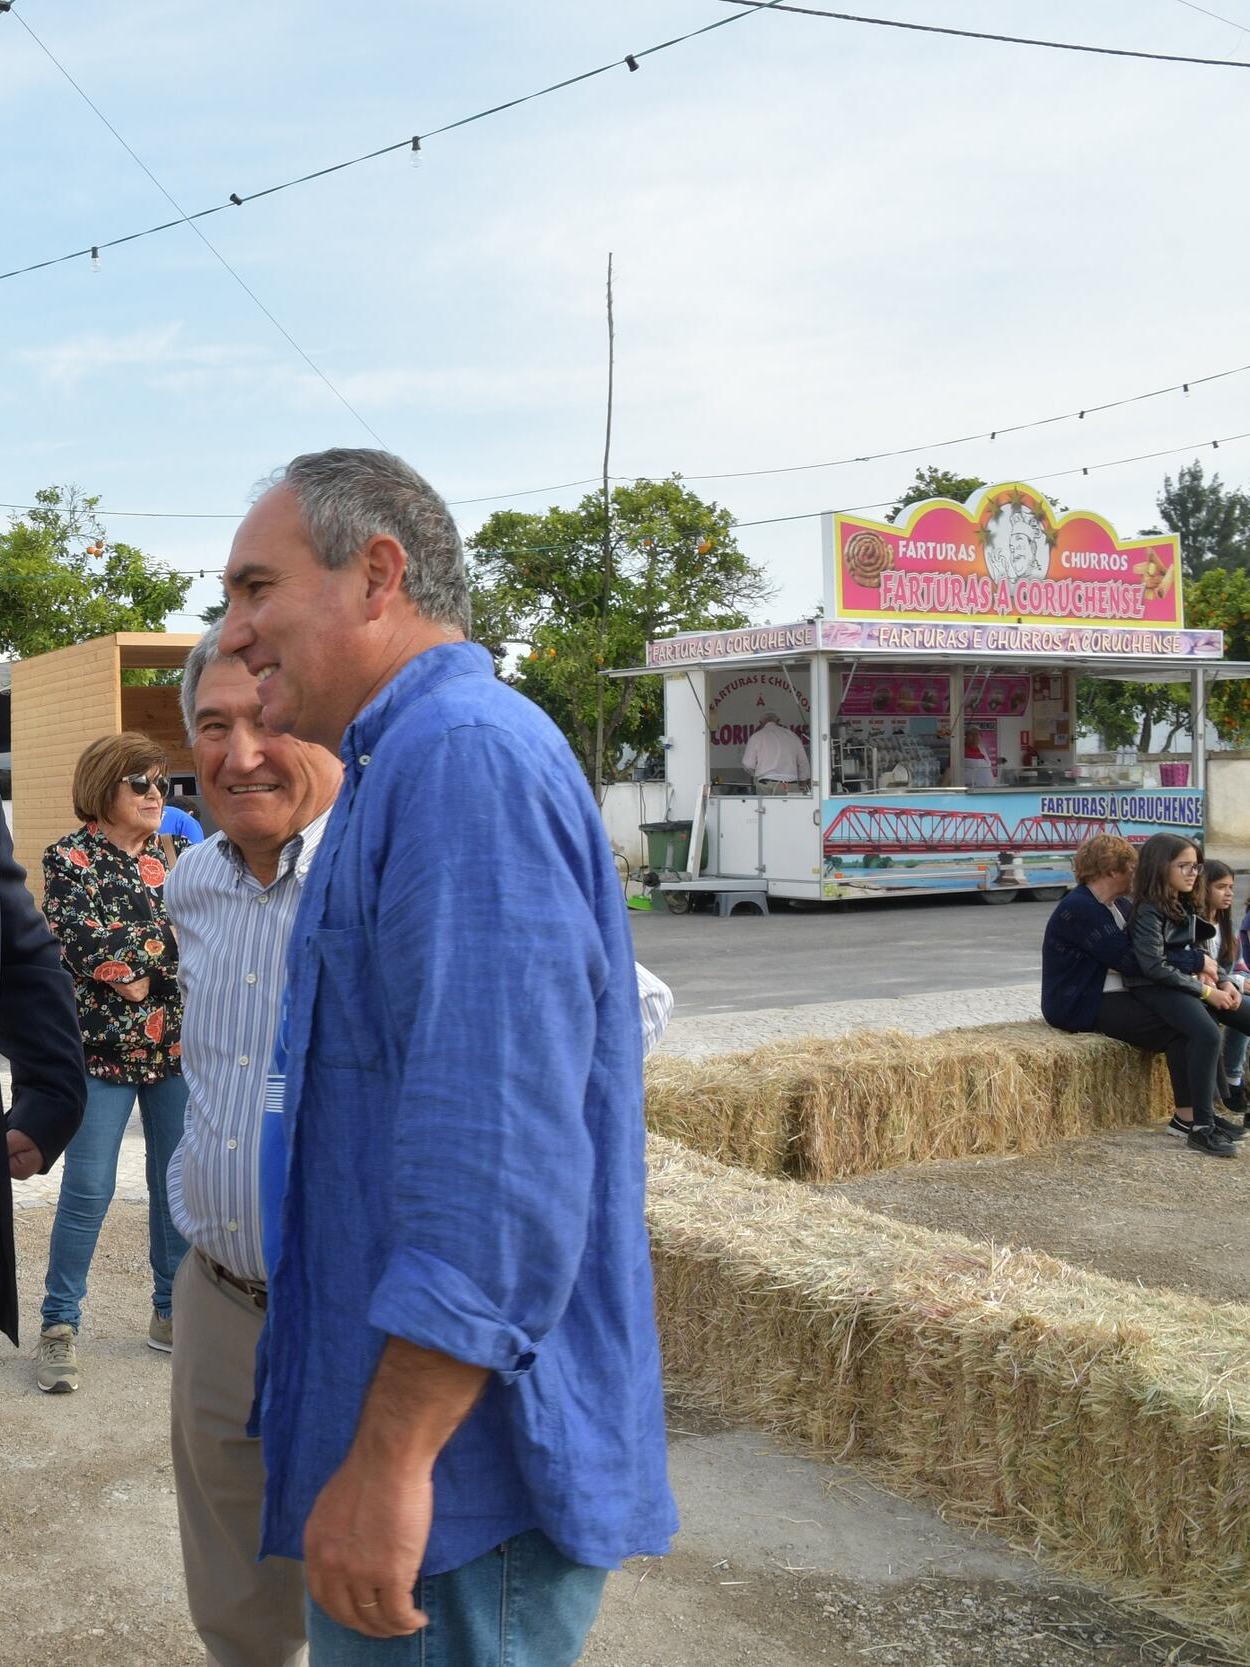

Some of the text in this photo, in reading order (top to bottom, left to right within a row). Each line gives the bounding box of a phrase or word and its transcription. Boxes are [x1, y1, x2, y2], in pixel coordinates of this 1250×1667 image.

[898, 540, 1128, 571] FARTURAS CHURROS
[880, 570, 993, 615] FARTURAS
[1014, 577, 1145, 619] CORUCHENSE
[652, 628, 814, 663] FARTURAS A CORUCHENSE
[879, 626, 1182, 655] FARTURAS E CHURROS A CORUCHENSE
[761, 675, 767, 684] E
[1041, 796, 1106, 817] FARTURAS
[1120, 796, 1202, 825] CORUCHENSE
